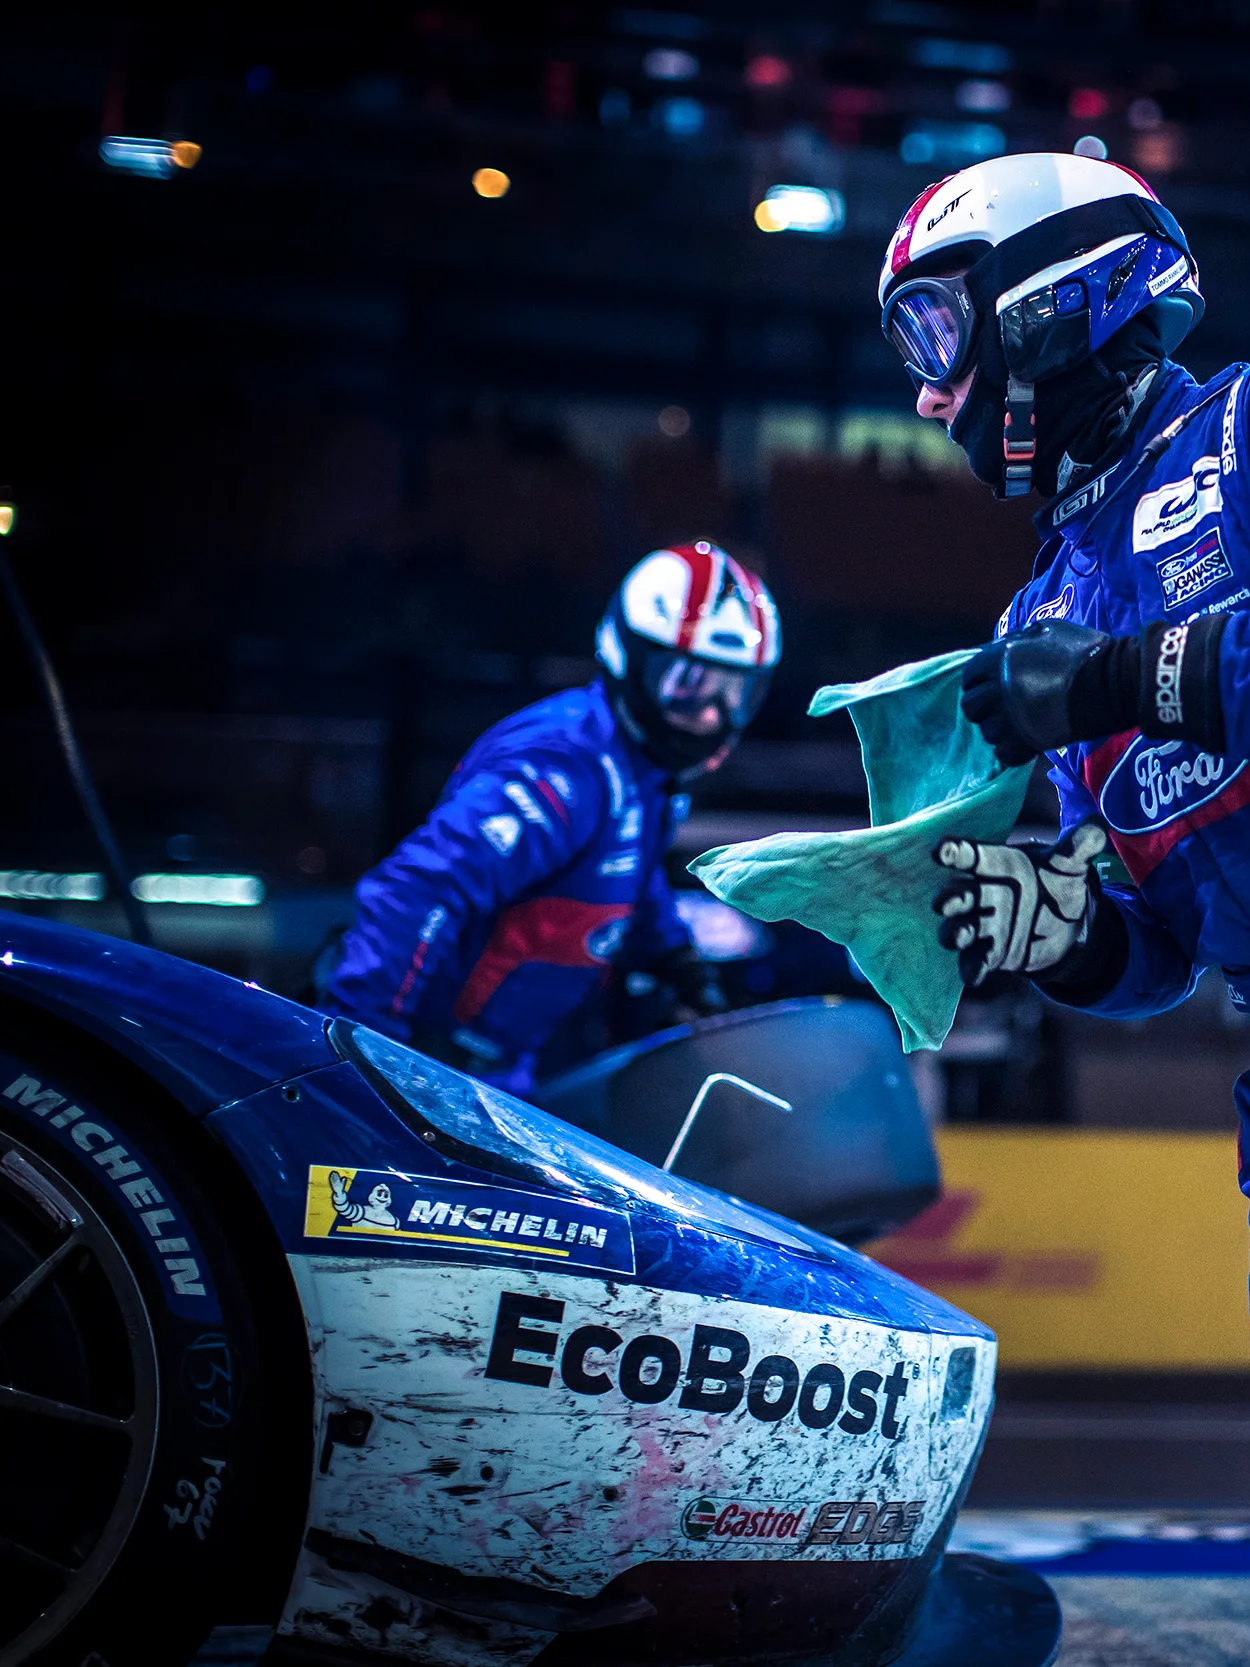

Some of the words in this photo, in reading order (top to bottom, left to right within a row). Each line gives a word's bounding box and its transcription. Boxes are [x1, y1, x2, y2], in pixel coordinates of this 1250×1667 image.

[1053, 459, 1123, 526] GT
[1167, 565, 1227, 604] RACING
[1156, 625, 1188, 723] sparco
[1134, 739, 1225, 820] Ford
[2, 1073, 206, 1296] MICHELIN
[407, 1199, 607, 1248] MICHELIN
[162, 1479, 200, 1531] 67
[713, 1503, 805, 1539] Castrol
[806, 1500, 927, 1545] EDGE
